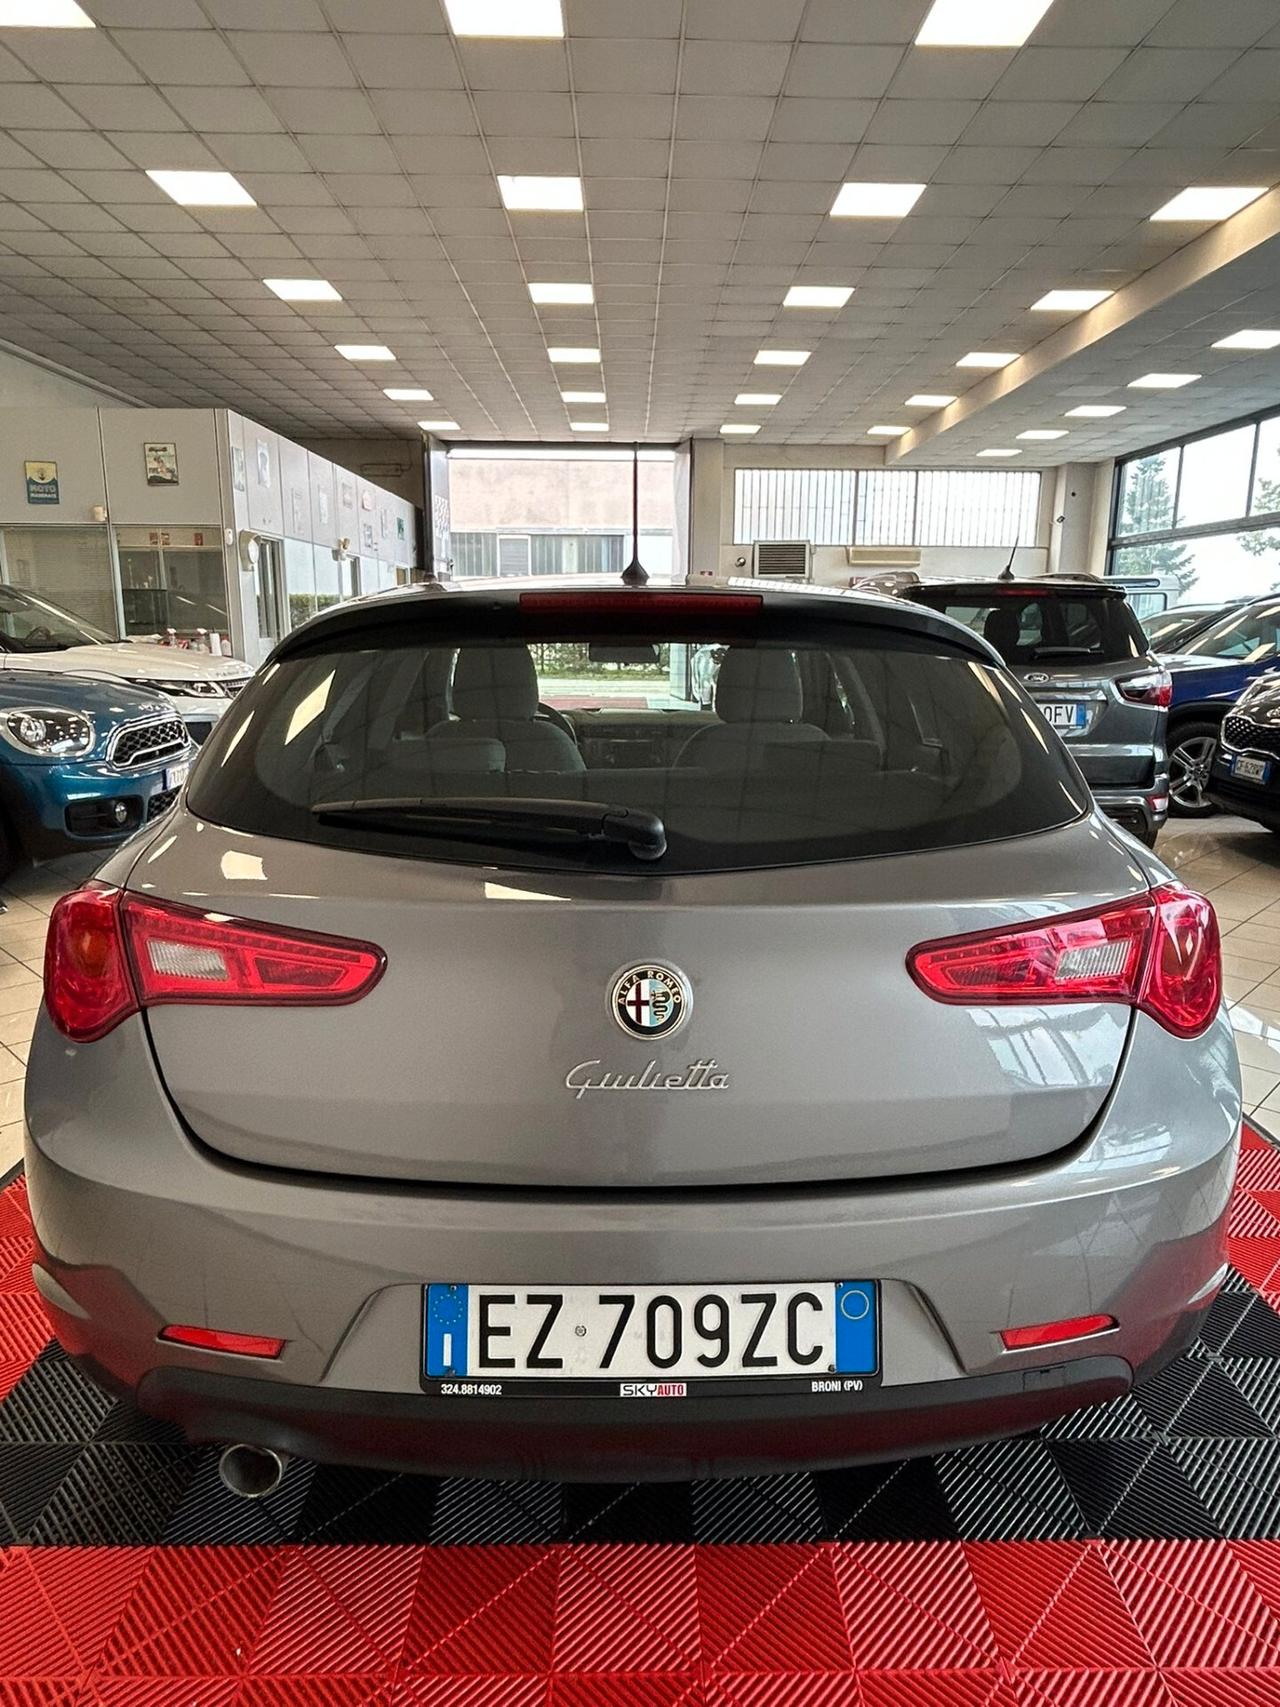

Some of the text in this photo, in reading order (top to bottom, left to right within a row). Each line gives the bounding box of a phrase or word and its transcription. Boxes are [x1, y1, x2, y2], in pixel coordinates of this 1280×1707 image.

[618, 970, 681, 1005] ALFA ROMEO
[565, 1059, 729, 1100] Giulietta
[479, 1294, 563, 1369] EZ
[599, 1292, 824, 1369] 709ZC
[440, 1383, 502, 1395] 324.8814902
[811, 1380, 863, 1392] BRONI (PV)
